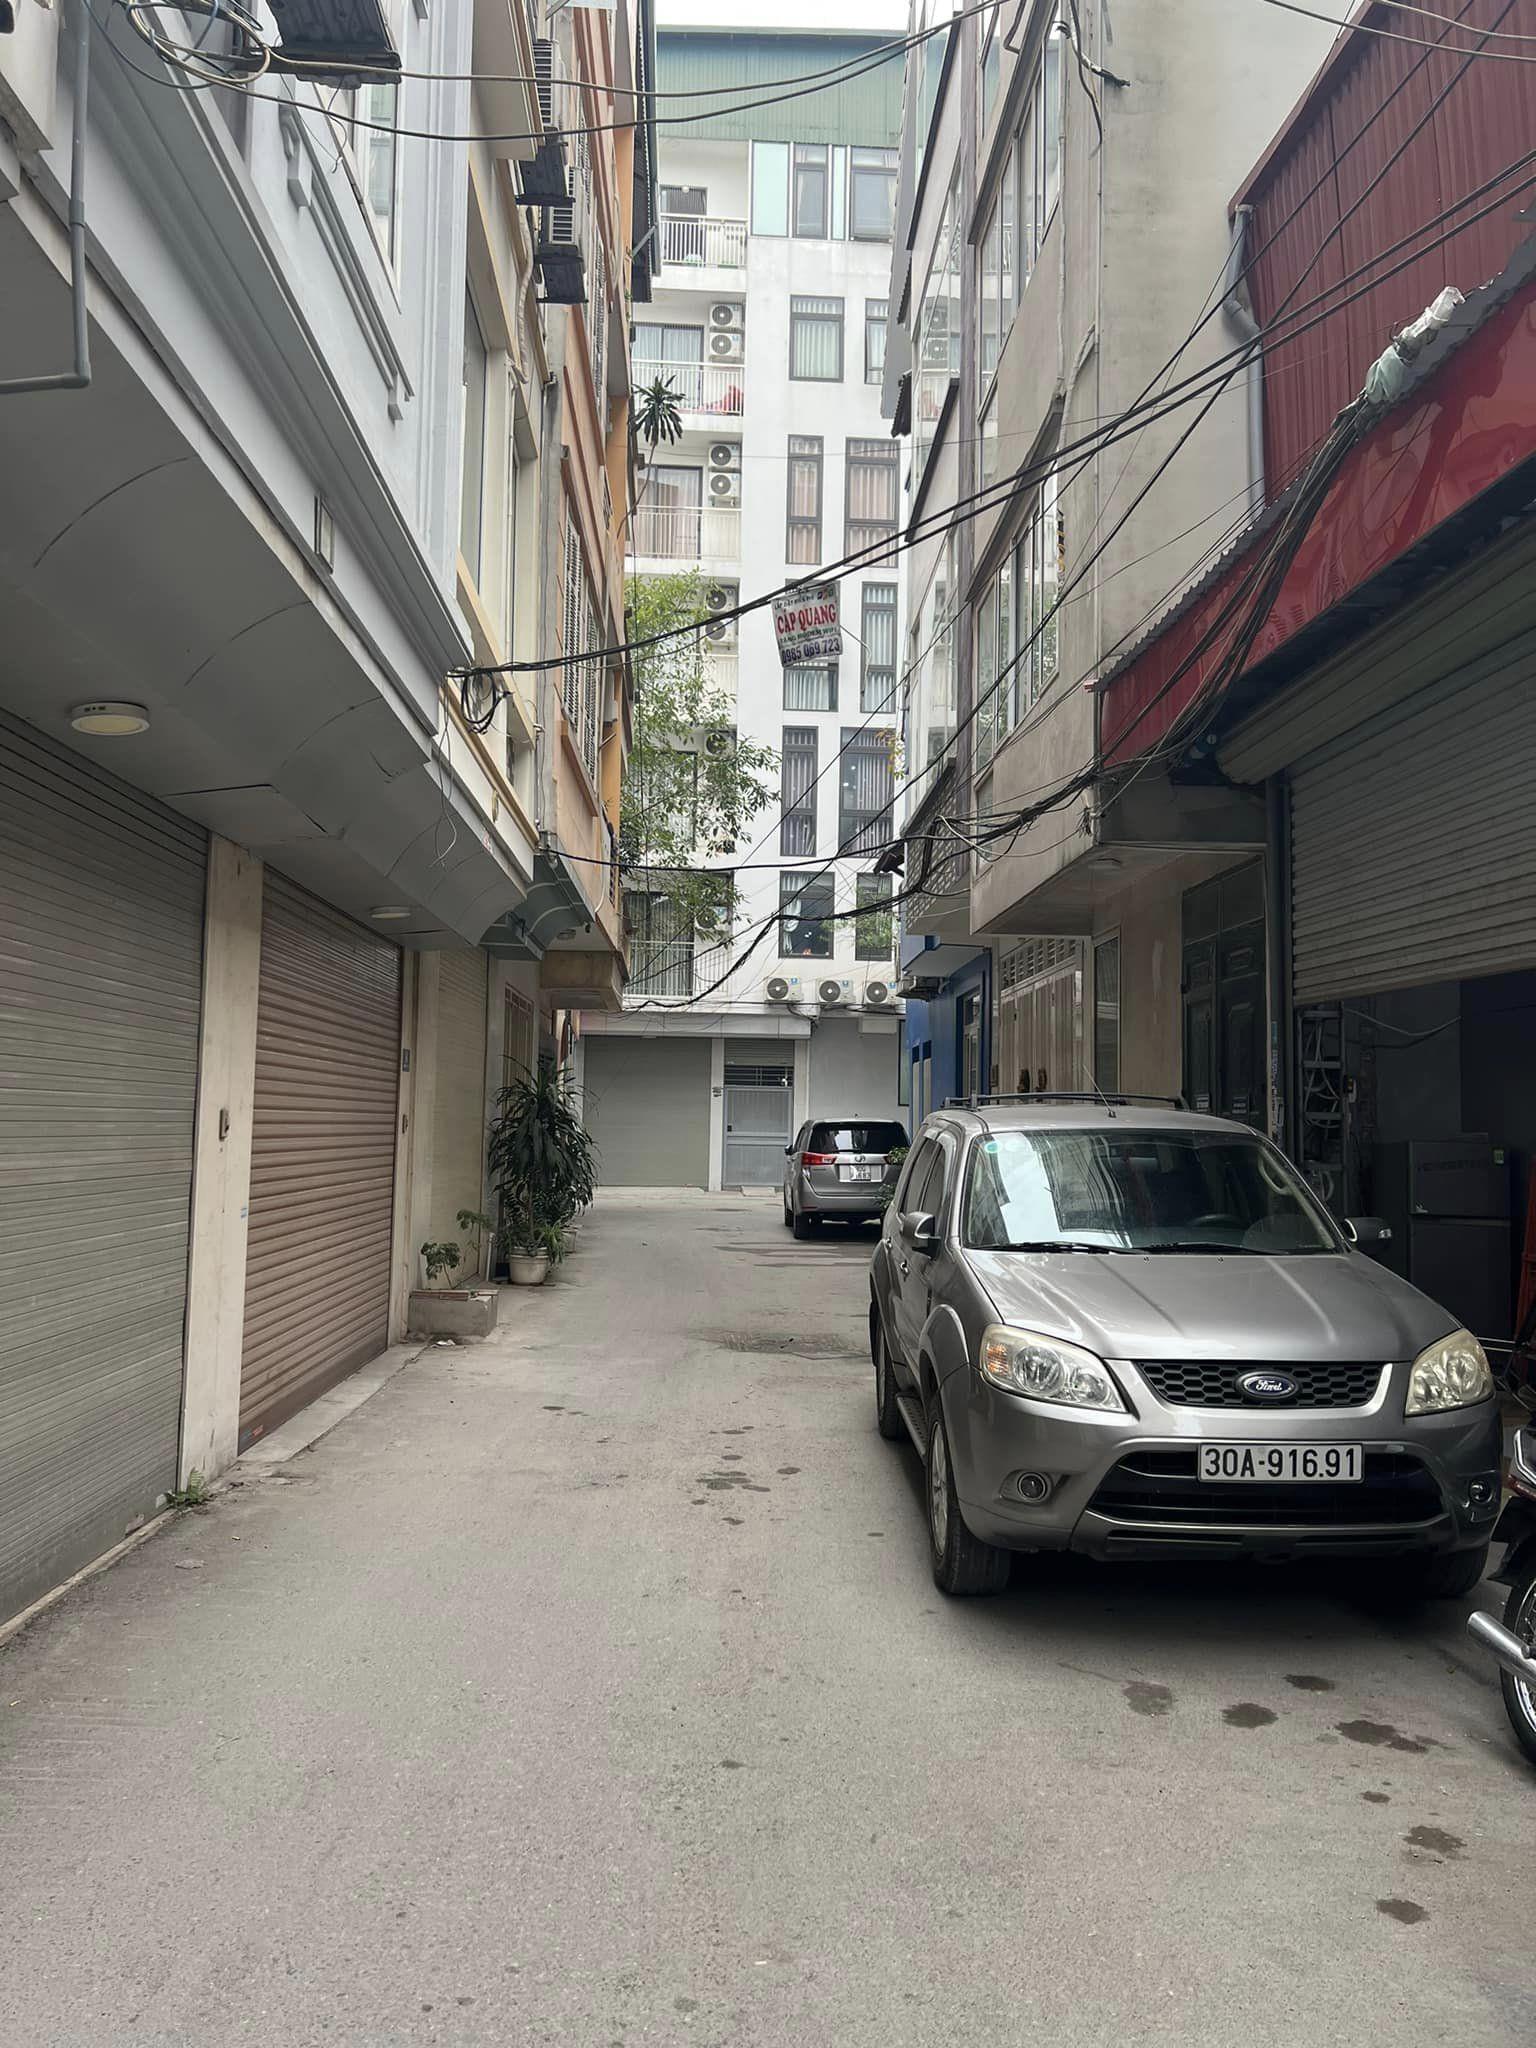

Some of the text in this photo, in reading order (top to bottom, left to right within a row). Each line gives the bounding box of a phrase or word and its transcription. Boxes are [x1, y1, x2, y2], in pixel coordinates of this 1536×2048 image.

[799, 604, 836, 631] QUANG
[803, 641, 820, 657] 069
[823, 638, 840, 654] 723
[1255, 1379, 1283, 1391] Ford
[1204, 1447, 1355, 1478] 30A-916.91
